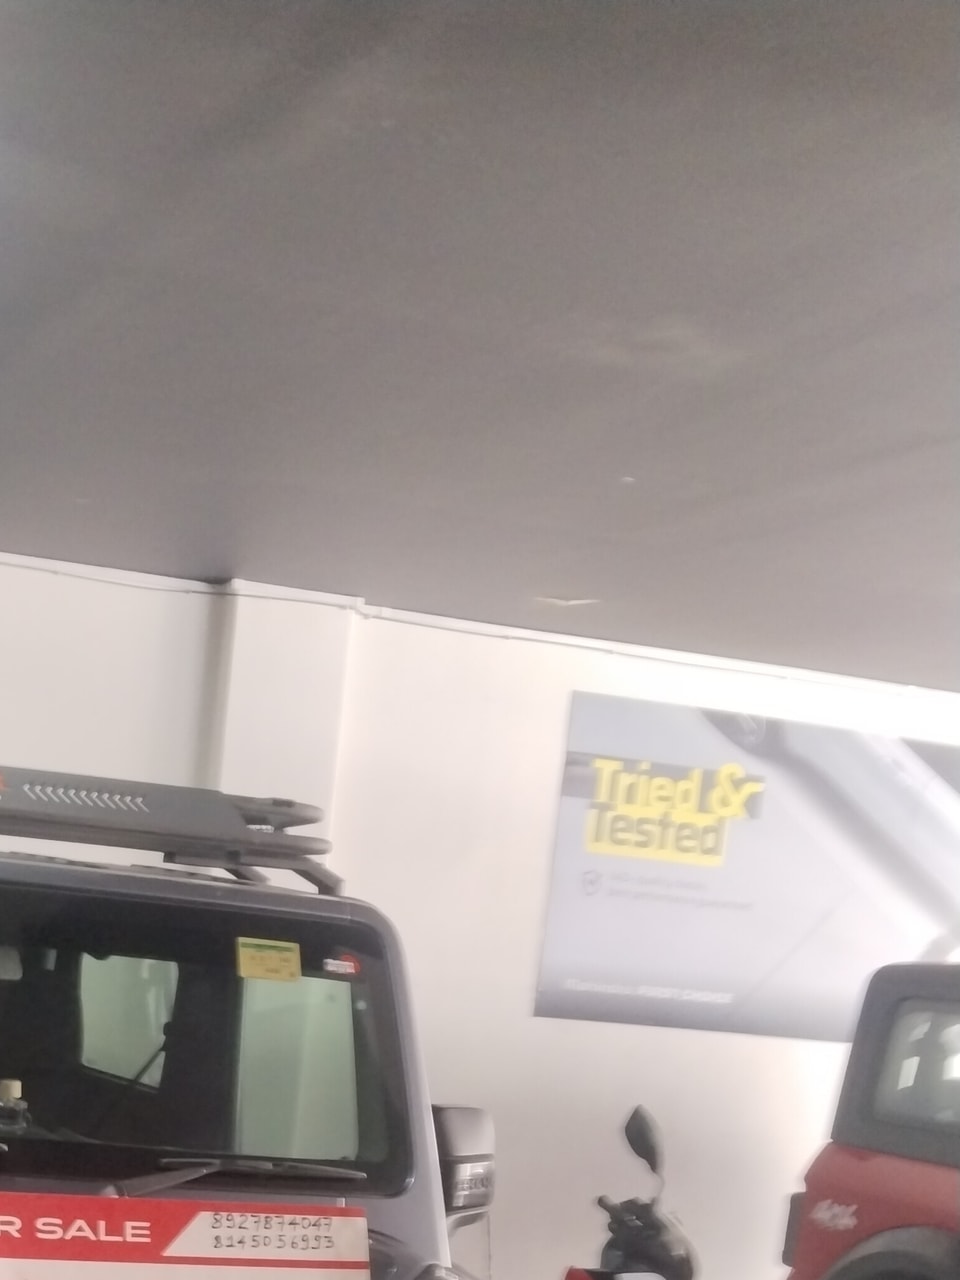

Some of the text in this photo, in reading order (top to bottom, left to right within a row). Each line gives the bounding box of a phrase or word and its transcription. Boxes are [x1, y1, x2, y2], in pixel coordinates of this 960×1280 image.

[593, 758, 766, 816] Tried &
[587, 802, 723, 855] Tested
[34, 1217, 152, 1243] SALE
[211, 1213, 333, 1232] 8927874047
[213, 1234, 335, 1251] 8145056993
